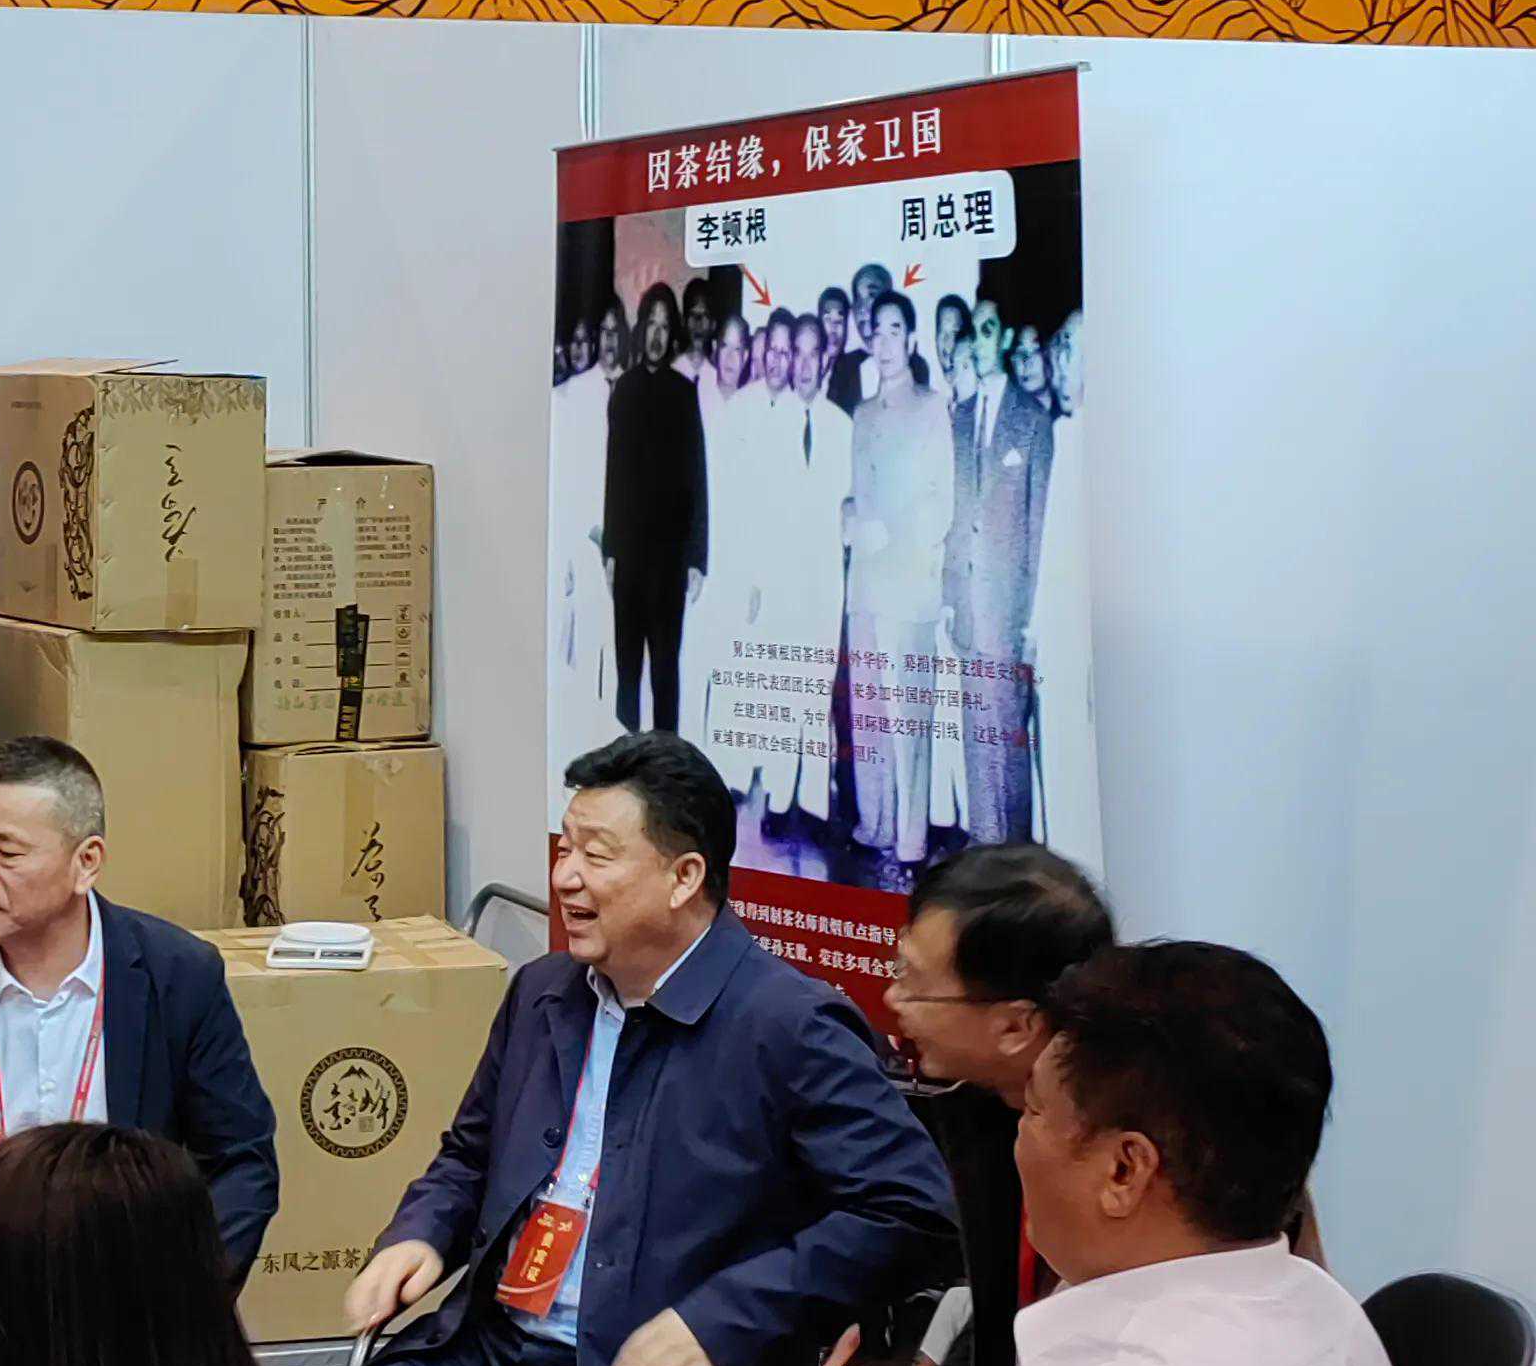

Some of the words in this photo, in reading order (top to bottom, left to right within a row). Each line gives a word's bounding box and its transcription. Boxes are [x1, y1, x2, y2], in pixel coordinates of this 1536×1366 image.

[646, 107, 943, 193] 因茶结缘，保家卫国
[696, 208, 767, 250] 李顿根
[900, 189, 995, 242] 周总理
